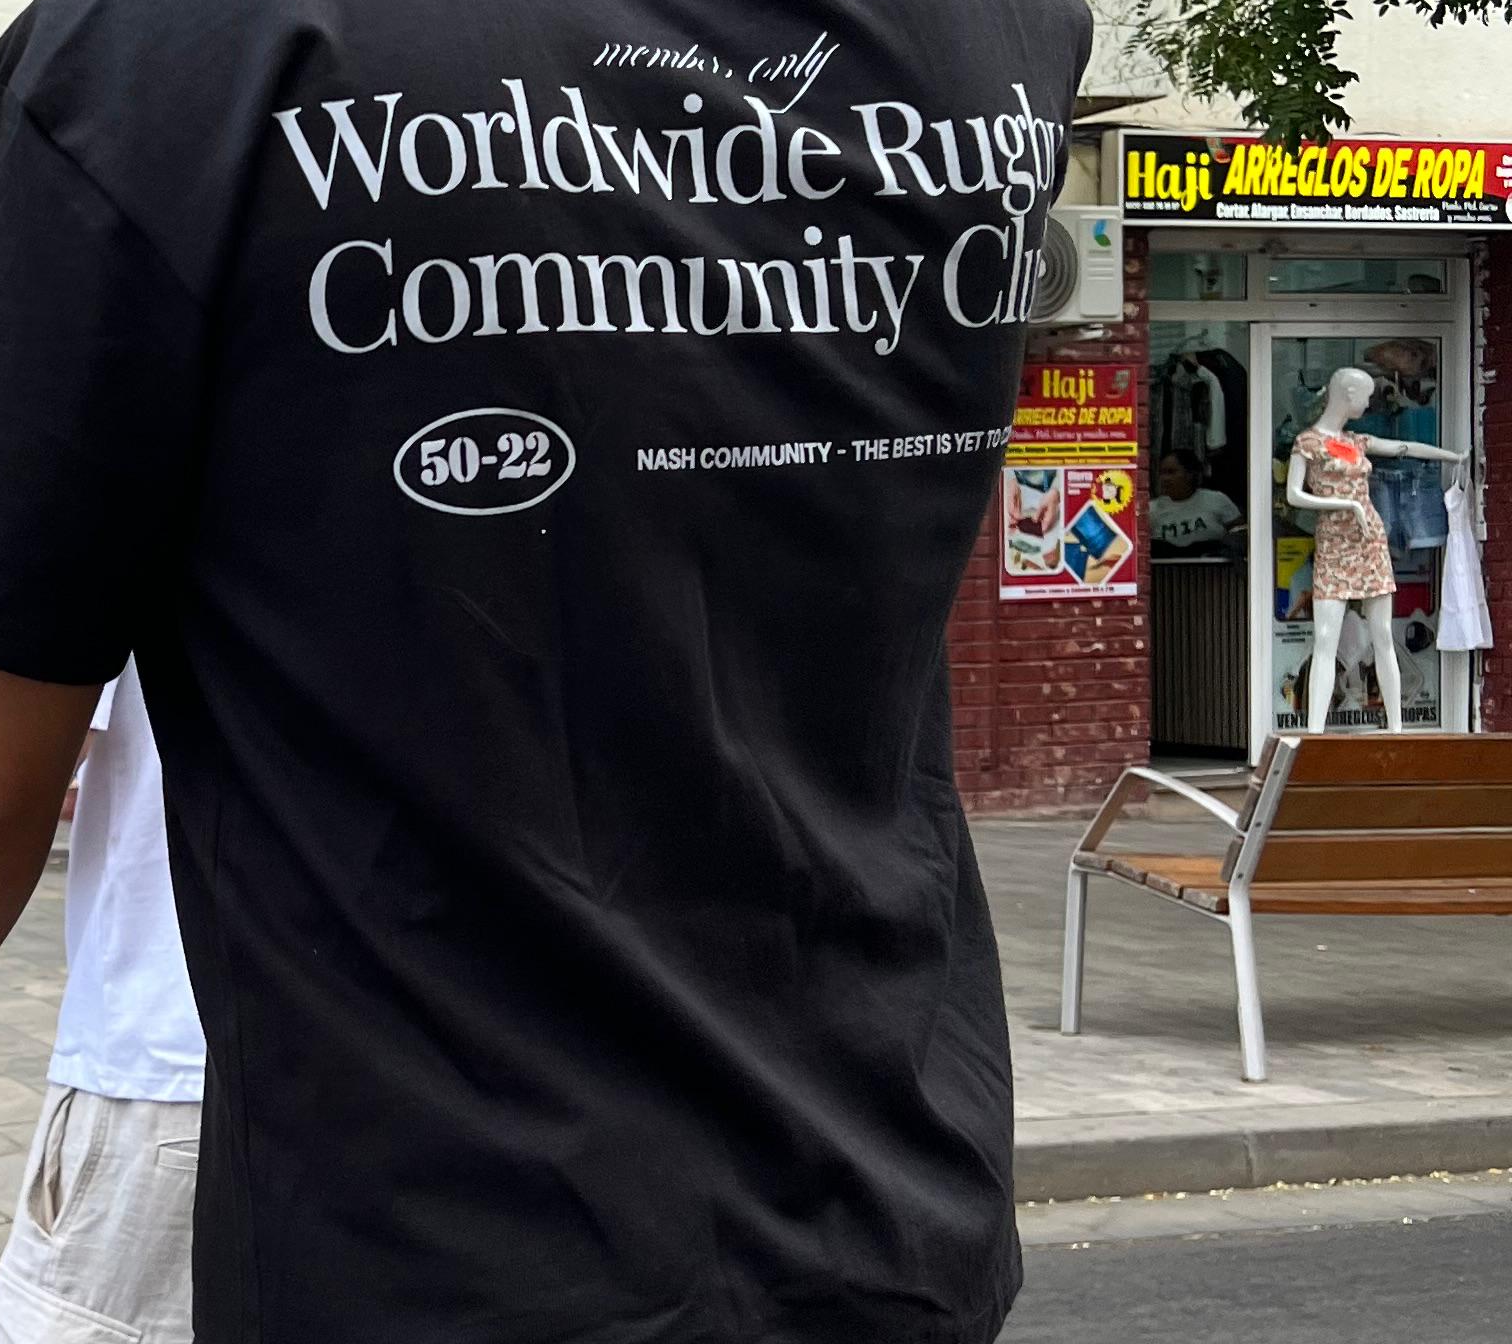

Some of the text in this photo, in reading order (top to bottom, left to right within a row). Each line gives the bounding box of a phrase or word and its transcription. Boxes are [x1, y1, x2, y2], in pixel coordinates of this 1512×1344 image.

[272, 78, 846, 212] Worldwide
[1222, 144, 1371, 197] ARREGLOS
[1371, 147, 1413, 198] DE
[1412, 148, 1486, 199] ROPA
[1127, 150, 1213, 212] Haji
[308, 215, 1045, 356] Community Clu
[1042, 369, 1096, 405] Haji
[1078, 407, 1098, 425] DE
[1098, 407, 1133, 425] ROPA
[419, 430, 553, 488] 50-22
[637, 447, 696, 471] NASH
[700, 442, 832, 469] COMMUNITY
[851, 439, 890, 462] THE
[892, 434, 934, 458] BEST
[935, 433, 951, 456] IS
[952, 430, 985, 454] YET
[985, 427, 1001, 450] TO
[1276, 712, 1309, 729] VENT
